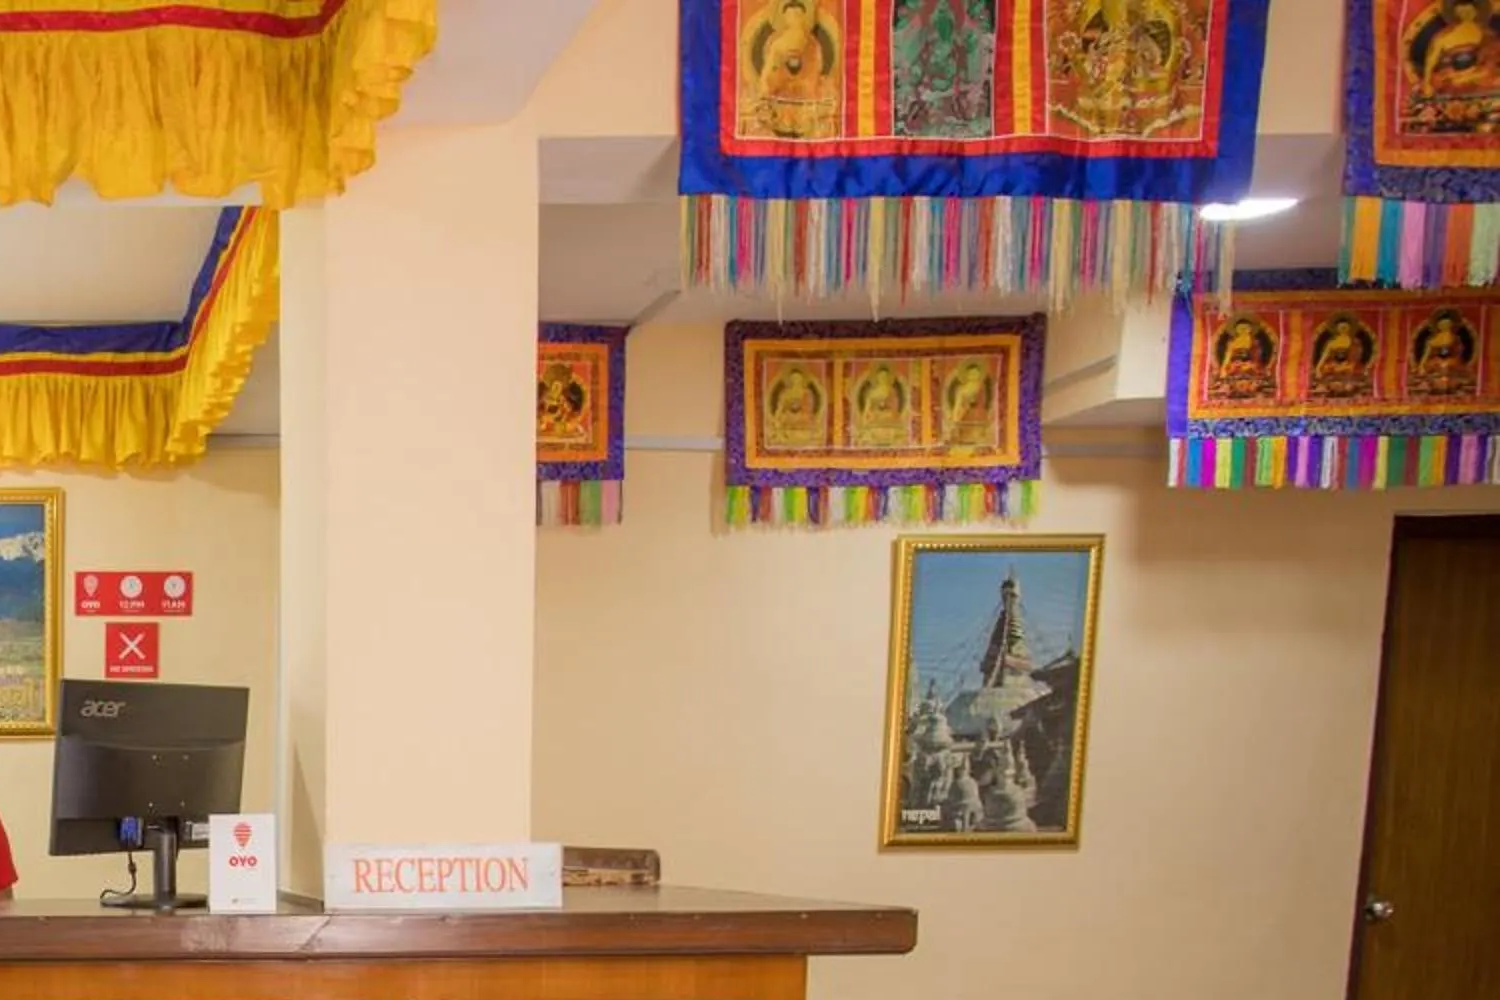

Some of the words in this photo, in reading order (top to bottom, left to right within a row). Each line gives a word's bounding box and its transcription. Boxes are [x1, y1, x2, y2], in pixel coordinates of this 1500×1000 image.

[80, 699, 126, 718] acer
[228, 856, 258, 867] OYO
[353, 857, 529, 894] RECEPTION
